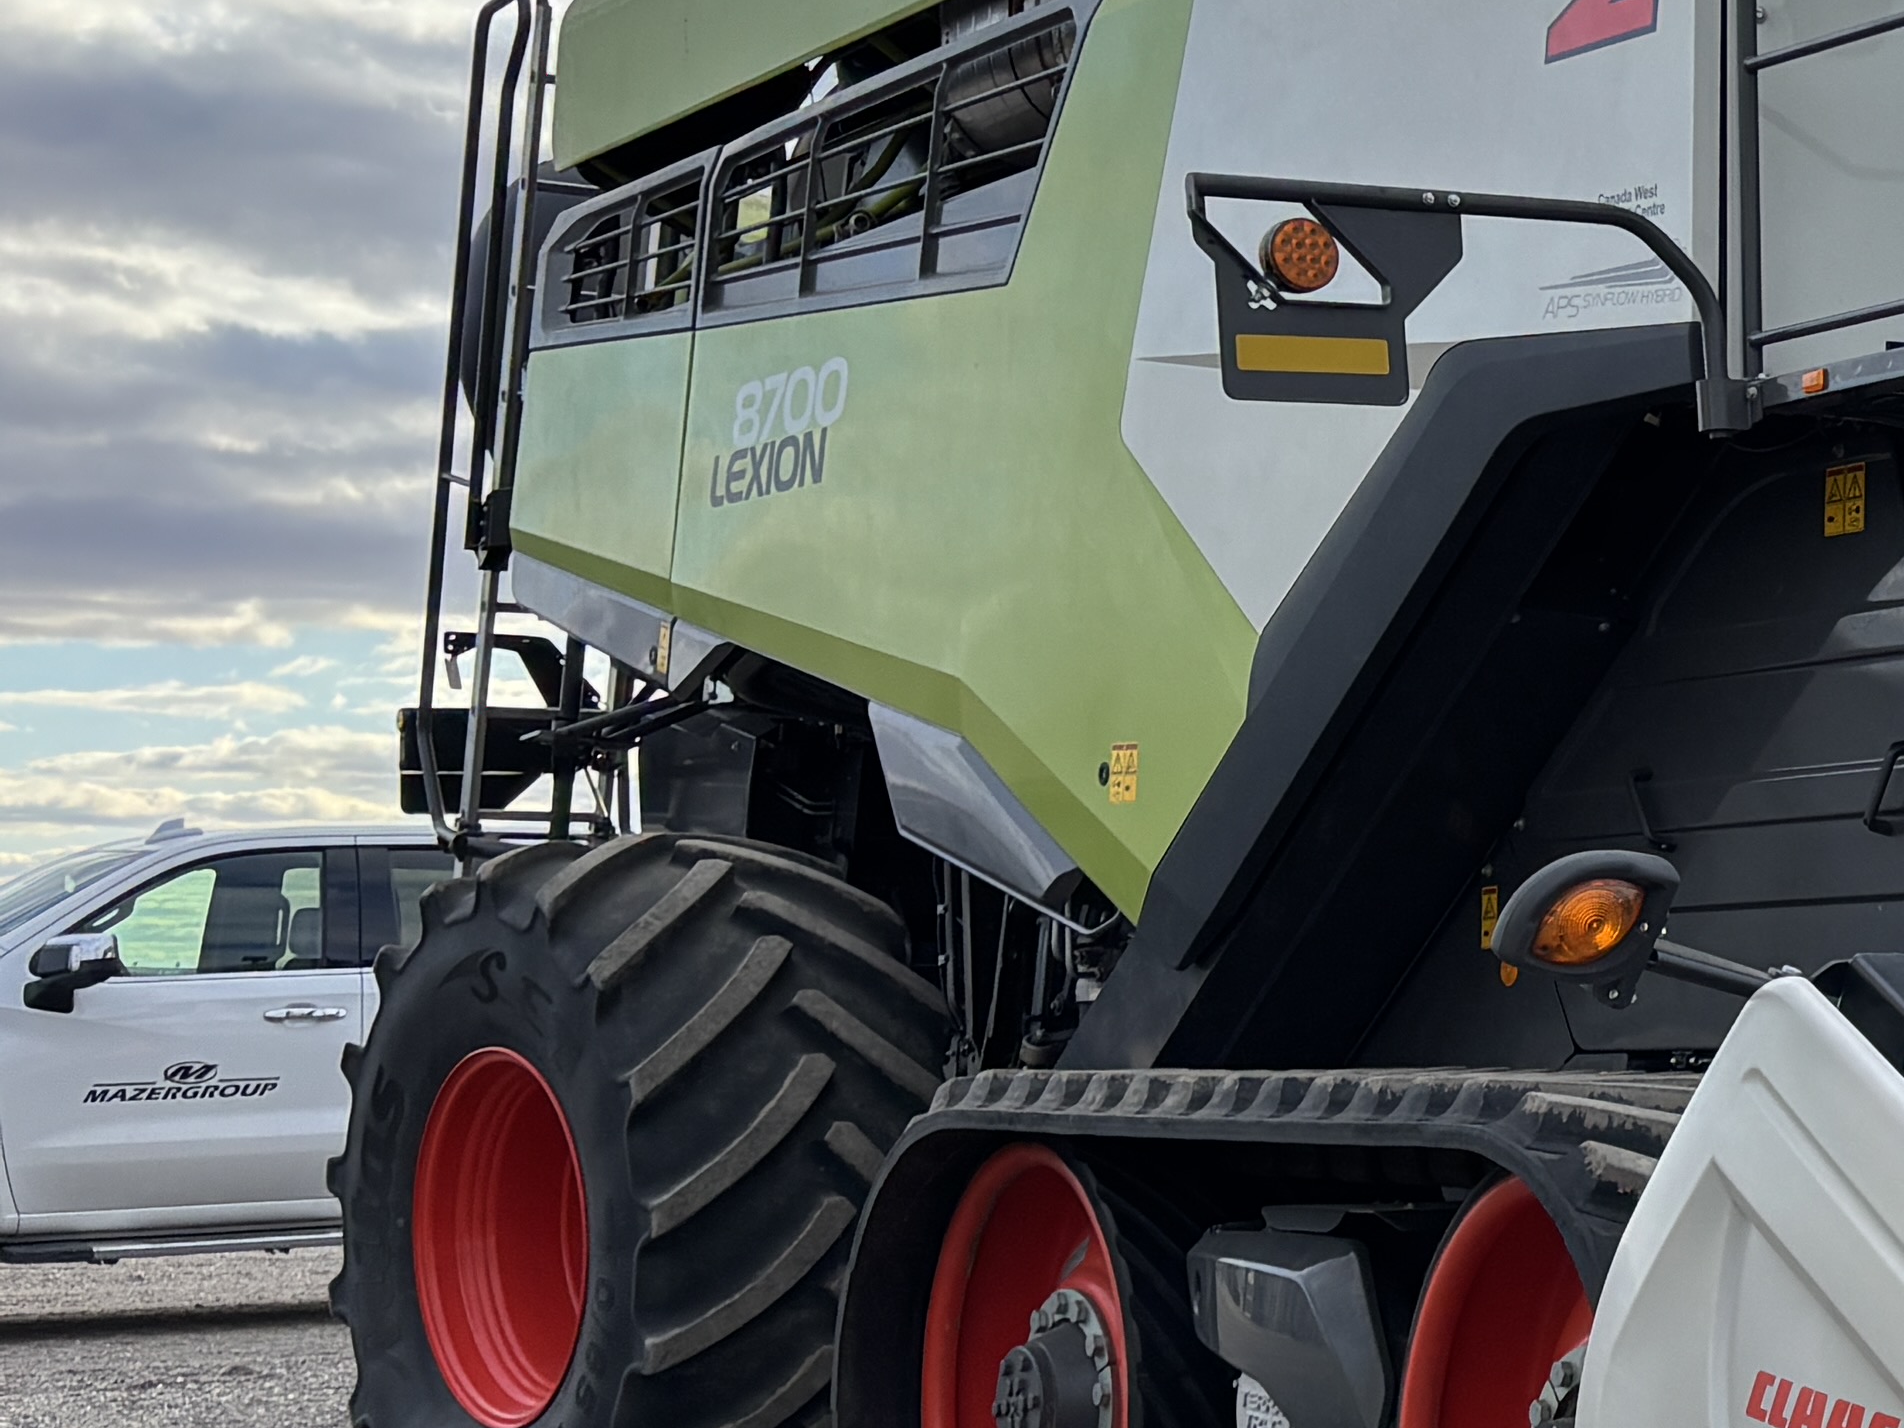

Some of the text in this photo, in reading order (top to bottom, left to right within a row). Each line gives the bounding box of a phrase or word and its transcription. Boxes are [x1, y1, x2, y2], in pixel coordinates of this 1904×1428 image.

[1634, 183, 1658, 201] West
[1542, 294, 1581, 321] APS
[733, 356, 848, 449] 8700
[710, 427, 828, 508] LEXION
[83, 1083, 278, 1103] MAZERGROUP
